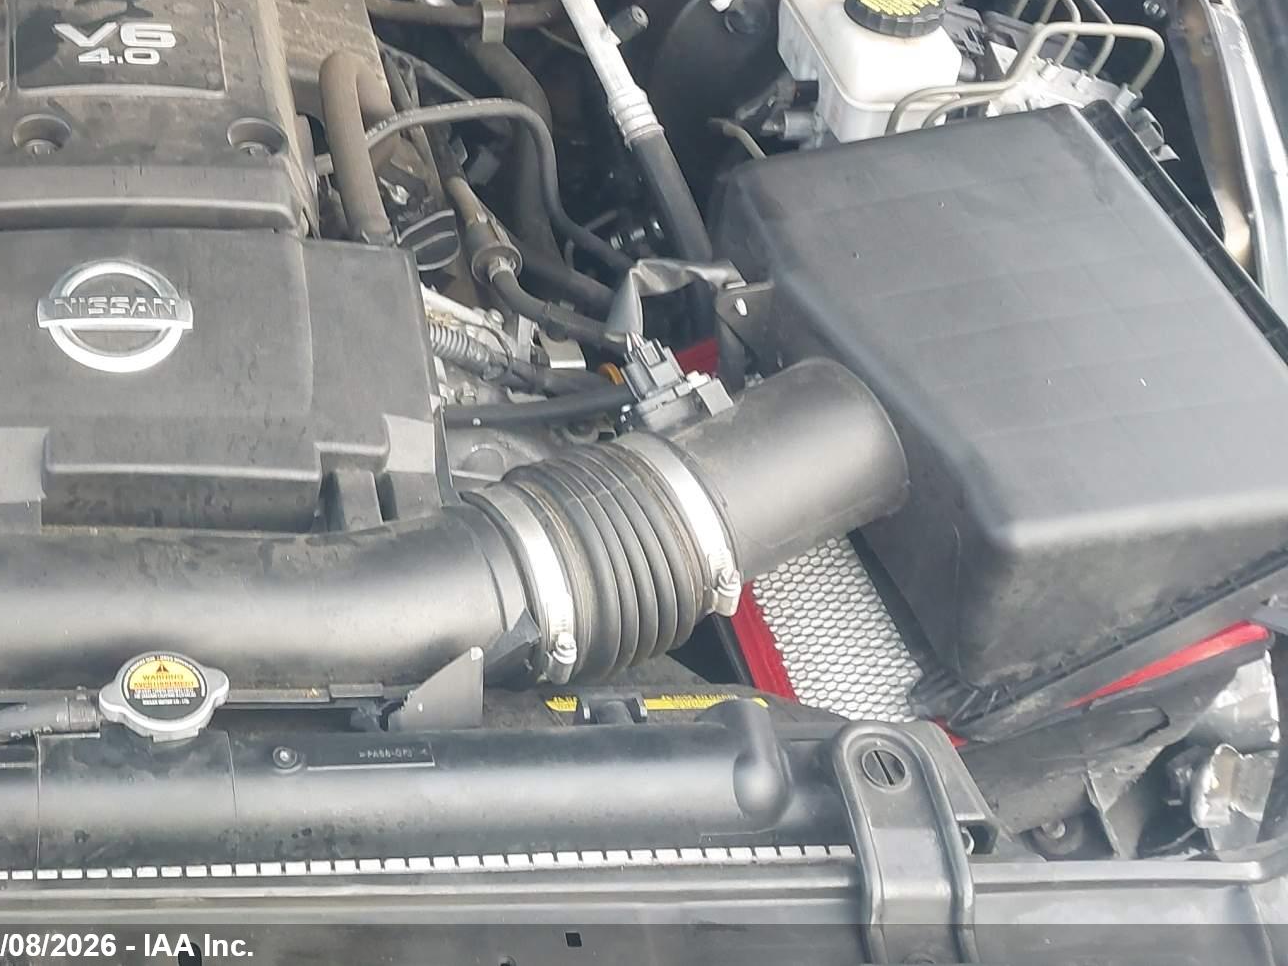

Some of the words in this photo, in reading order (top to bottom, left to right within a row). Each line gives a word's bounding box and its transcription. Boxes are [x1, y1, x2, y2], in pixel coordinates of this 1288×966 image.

[53, 21, 176, 47] V6
[78, 47, 160, 65] 4.0
[54, 296, 177, 318] NISSAN
